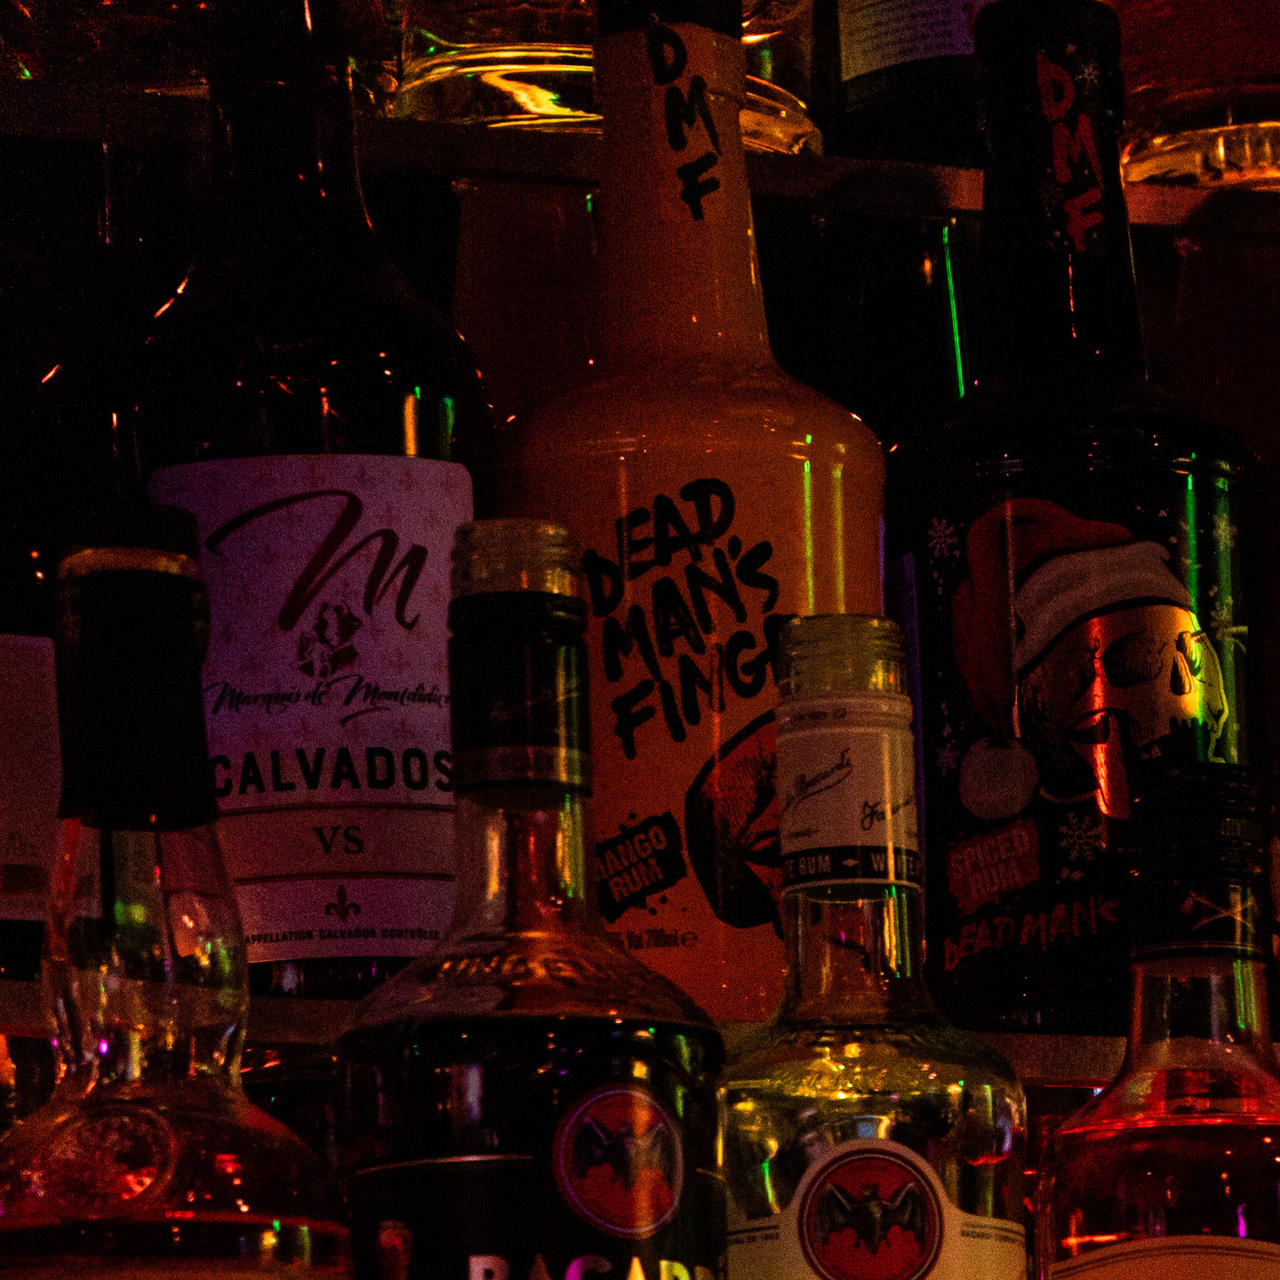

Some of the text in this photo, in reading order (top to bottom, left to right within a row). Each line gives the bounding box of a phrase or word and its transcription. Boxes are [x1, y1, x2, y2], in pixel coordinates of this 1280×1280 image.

[582, 477, 736, 617] DEAD
[601, 534, 780, 682] MAN'S
[209, 746, 454, 799] CALVADOS
[313, 824, 364, 855] VS
[950, 826, 1031, 880] SPICED
[608, 857, 664, 903] RUM
[968, 858, 1022, 902] RUM
[943, 915, 1017, 972] DEAD
